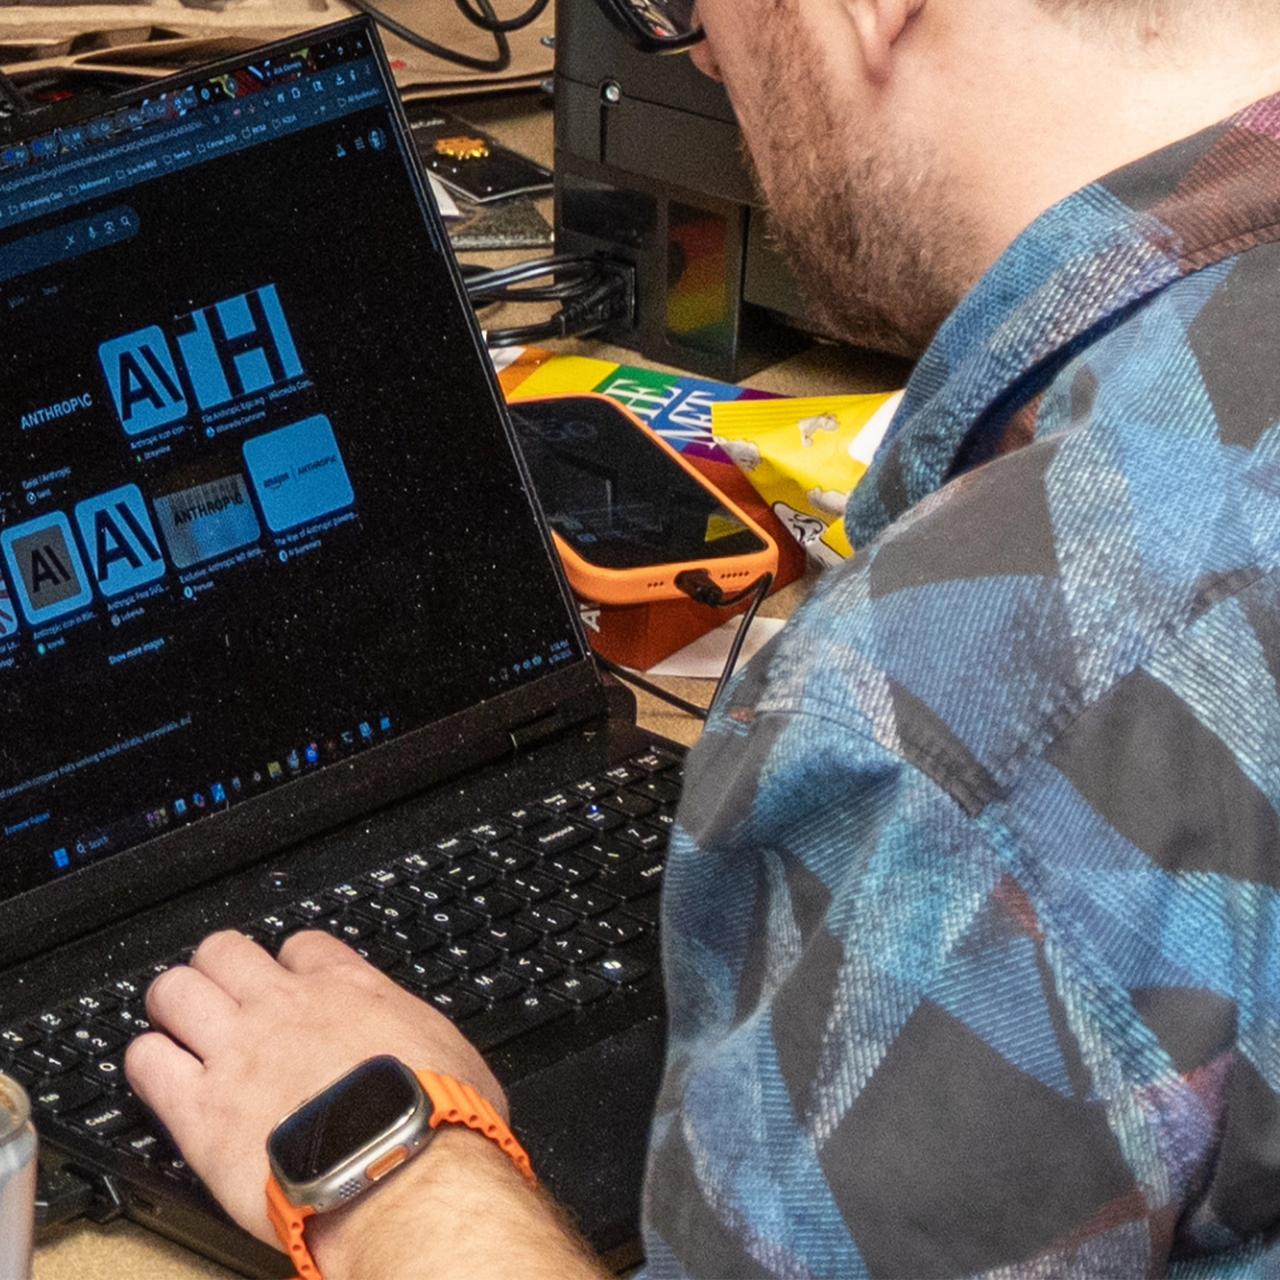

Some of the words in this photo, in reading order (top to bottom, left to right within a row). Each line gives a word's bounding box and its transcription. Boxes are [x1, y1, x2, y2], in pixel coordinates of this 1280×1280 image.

[108, 651, 126, 666] Show
[144, 638, 165, 655] images
[75, 753, 100, 770] working
